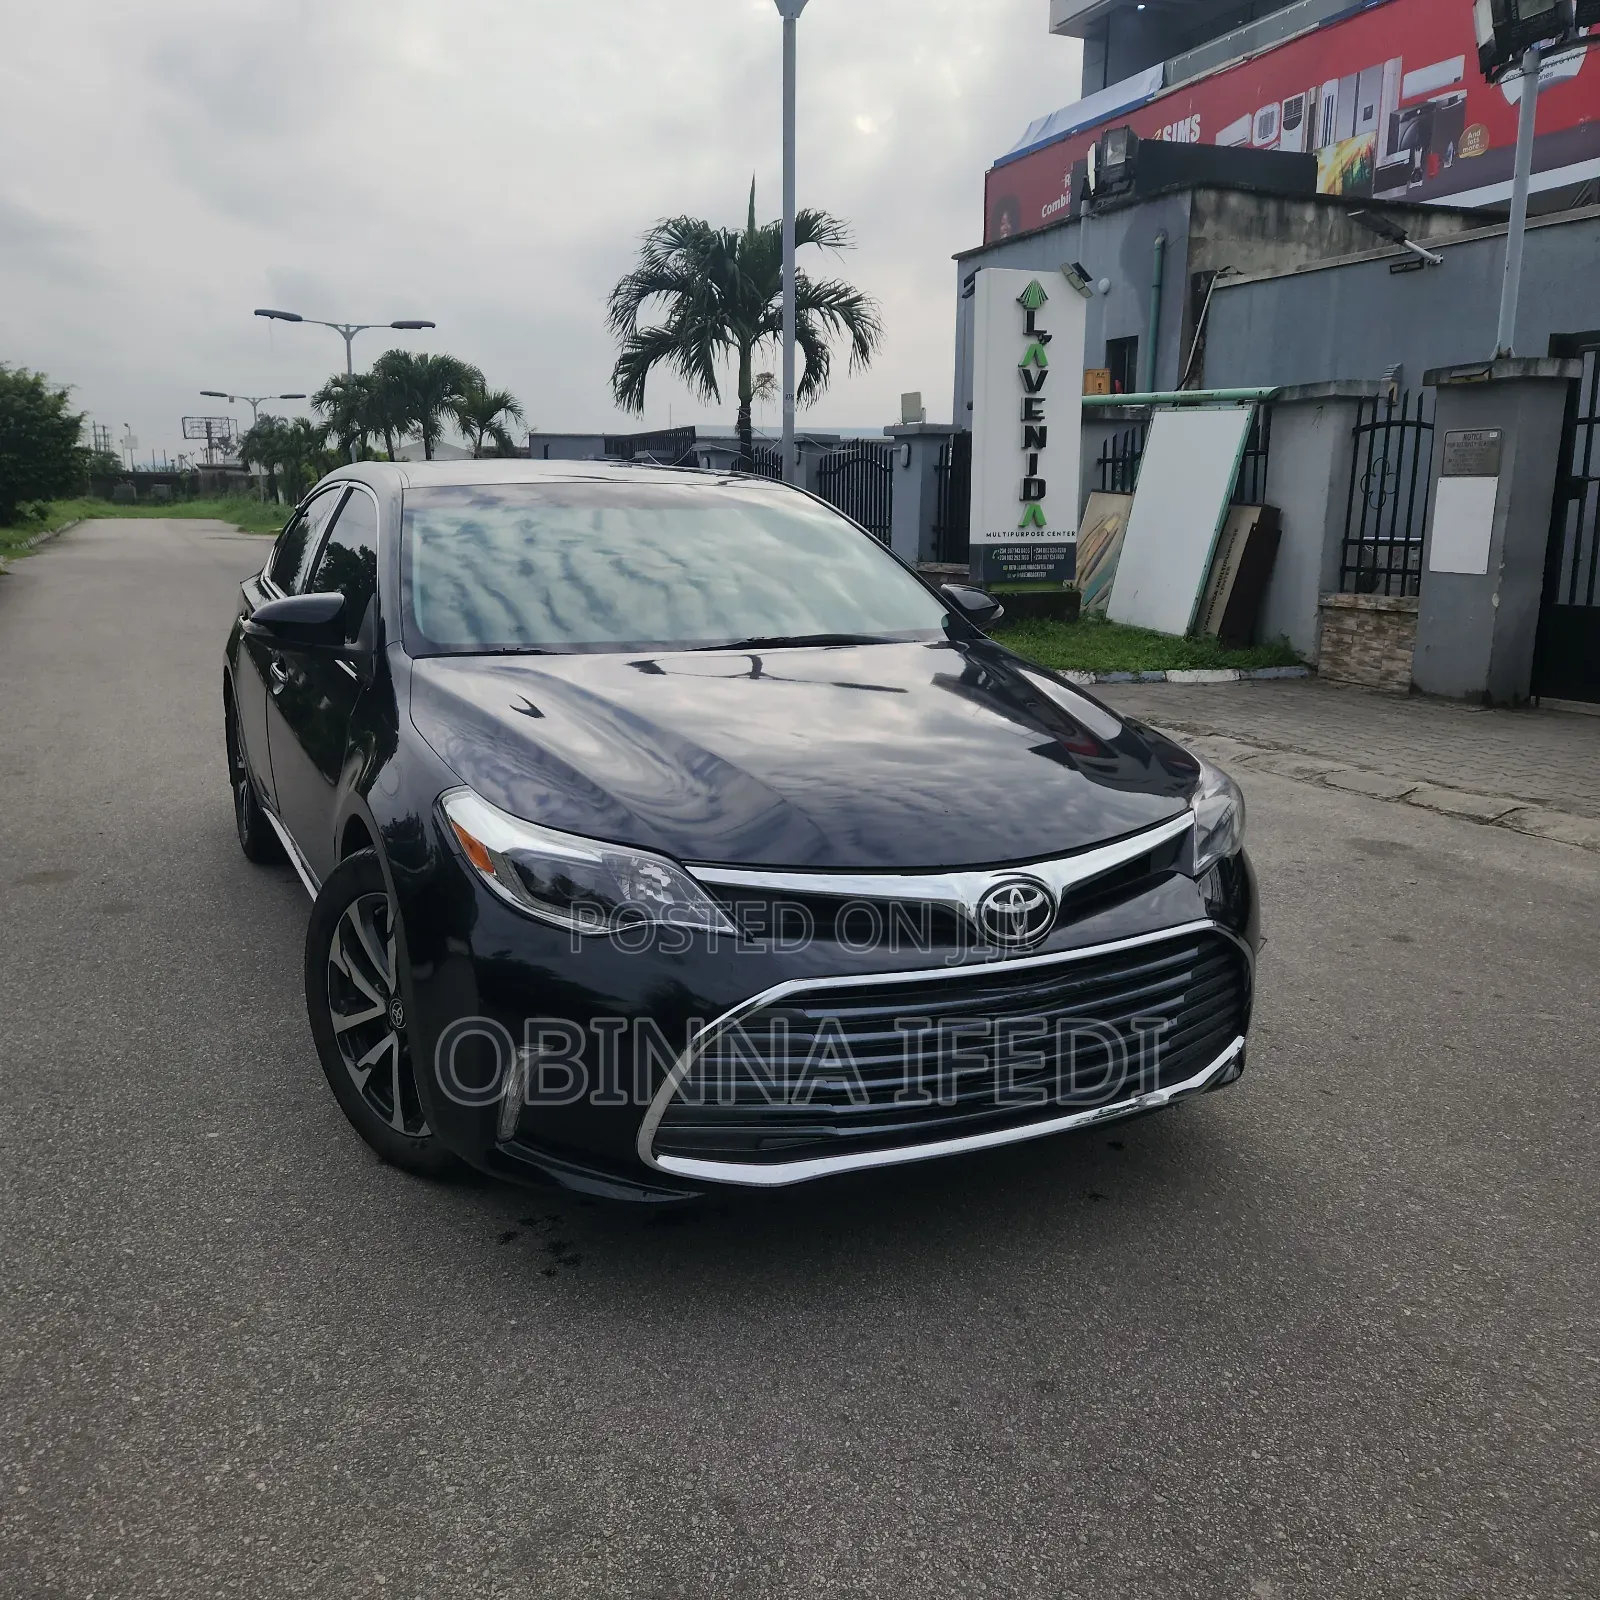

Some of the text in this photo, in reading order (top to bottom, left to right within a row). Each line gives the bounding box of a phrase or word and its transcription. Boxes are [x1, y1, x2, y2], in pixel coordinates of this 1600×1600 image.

[1468, 129, 1481, 139] And
[1468, 137, 1480, 145] lots
[1042, 191, 1071, 218] Combi
[1463, 432, 1484, 441] NOTICE
[1217, 528, 1239, 589] MULTIPURPOSE
[1220, 566, 1231, 595] CENTER
